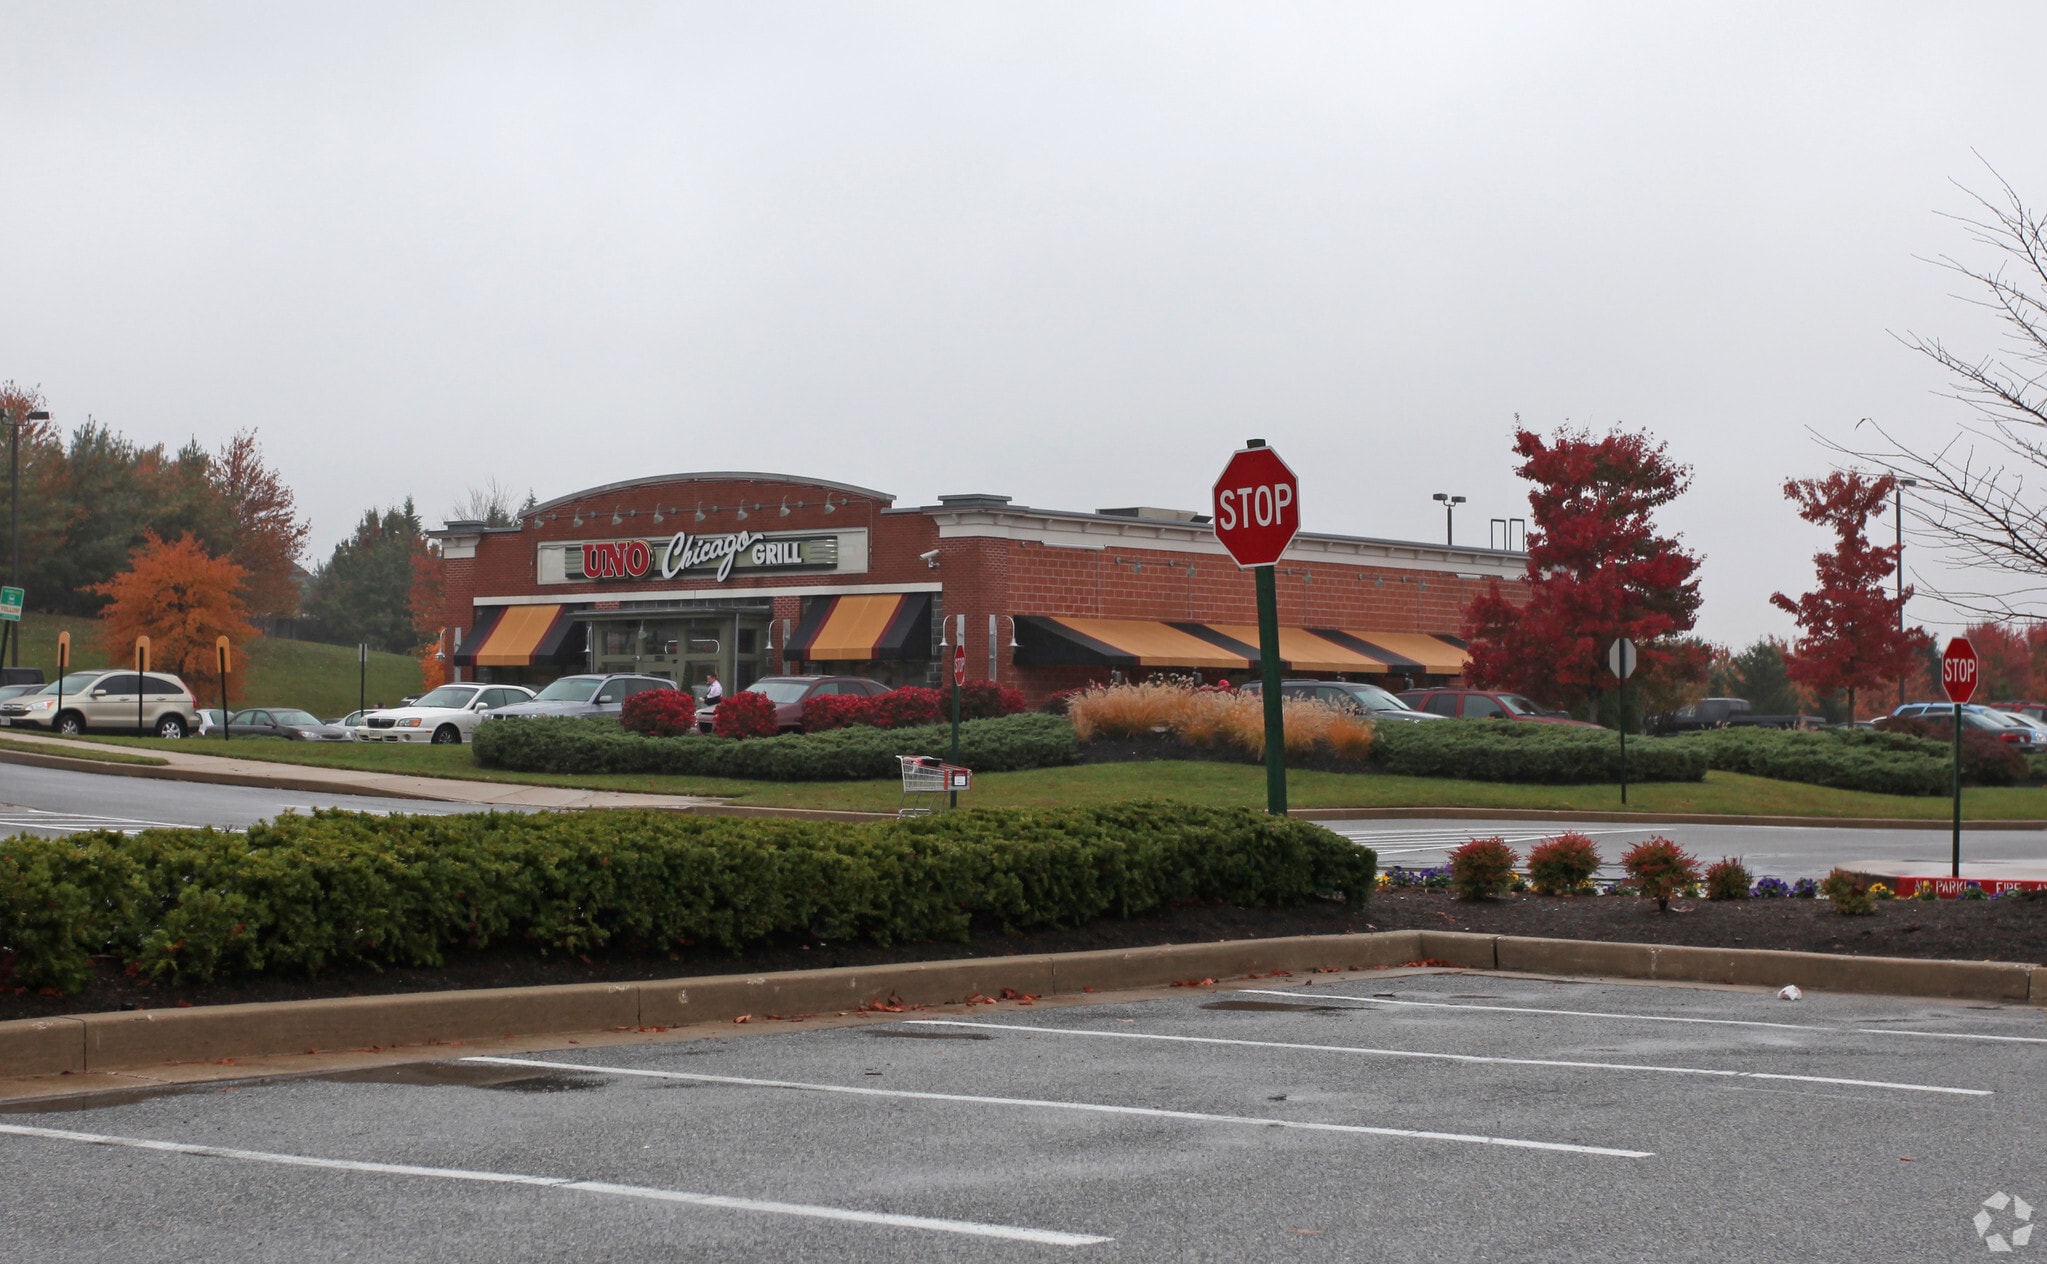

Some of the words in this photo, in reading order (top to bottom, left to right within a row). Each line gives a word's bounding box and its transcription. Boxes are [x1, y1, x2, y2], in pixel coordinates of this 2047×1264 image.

[1219, 483, 1292, 531] STOP
[582, 542, 651, 578] UNO
[661, 531, 764, 582] Chicago
[752, 542, 802, 565] GRILL
[1944, 658, 1975, 682] STOP
